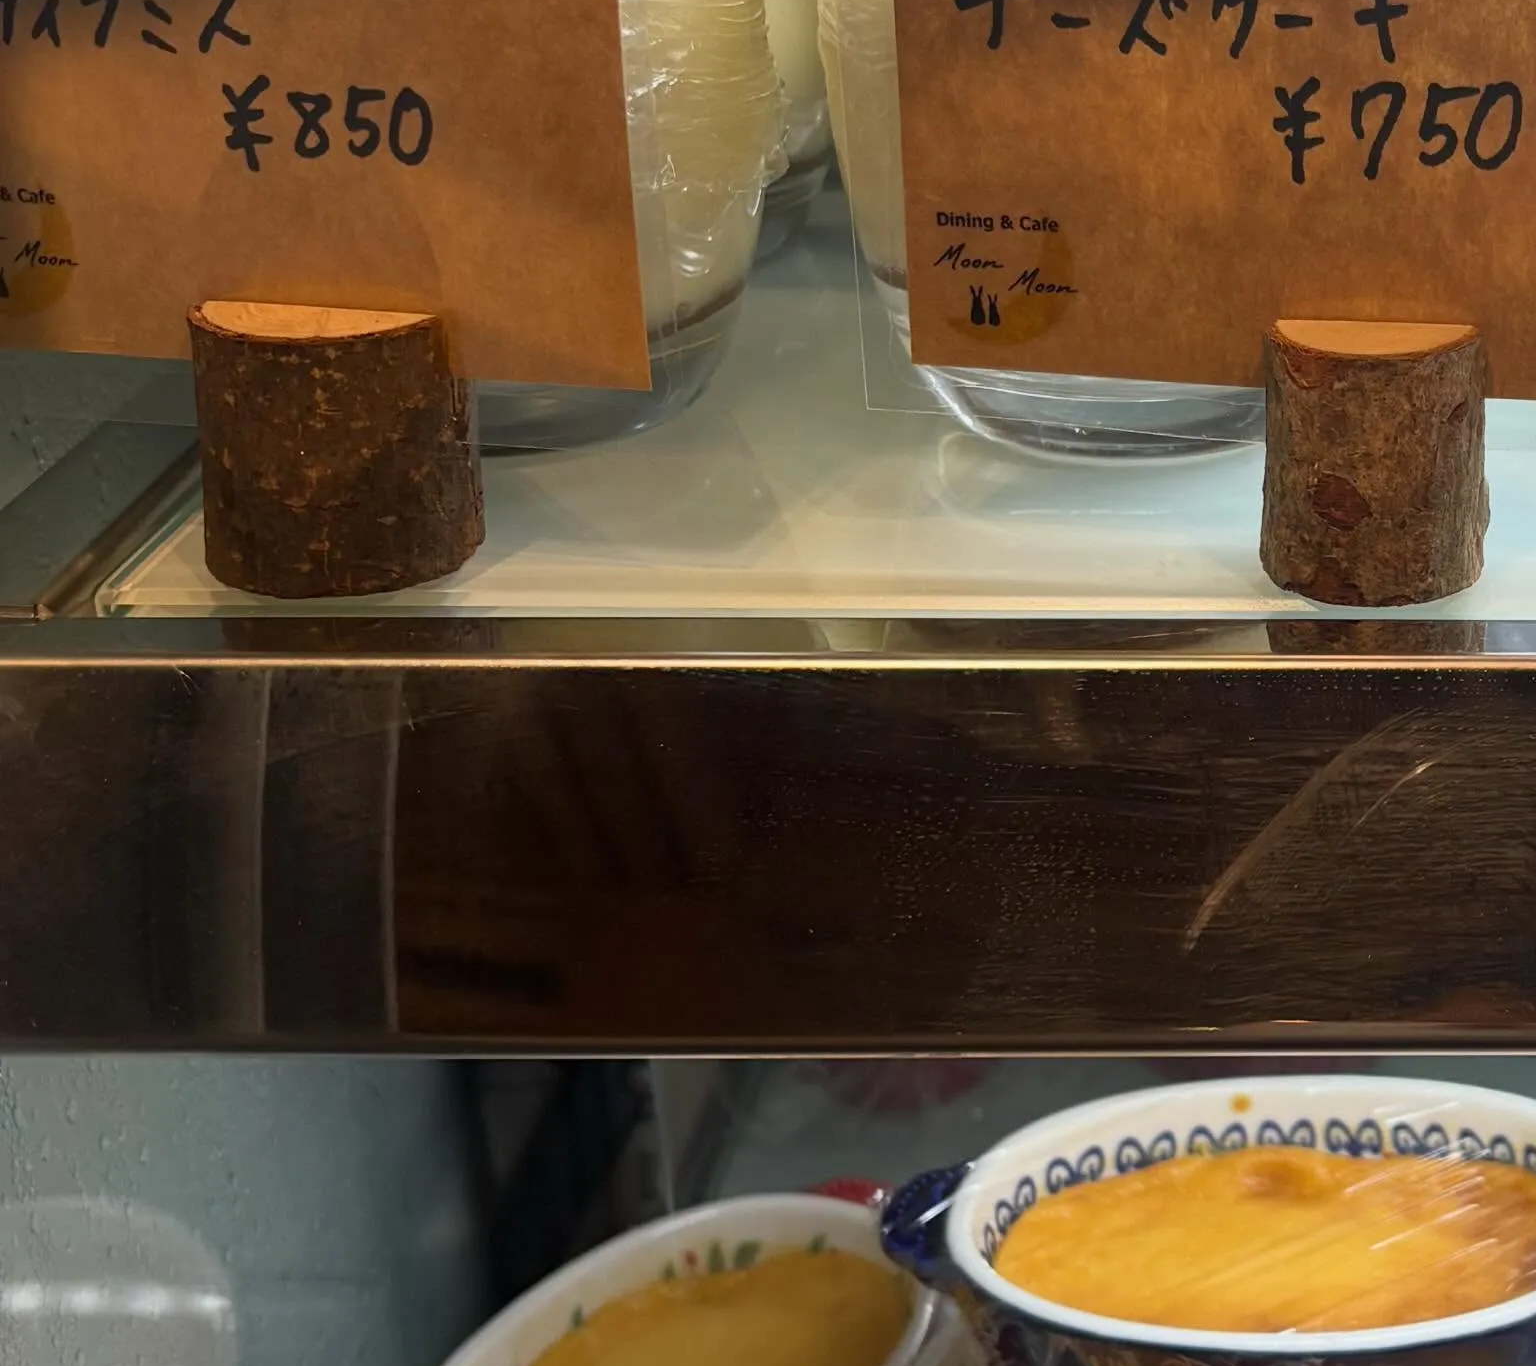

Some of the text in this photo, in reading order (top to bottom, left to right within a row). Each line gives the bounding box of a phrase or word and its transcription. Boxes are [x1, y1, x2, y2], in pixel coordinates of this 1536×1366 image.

[222, 74, 434, 172] ¥850
[1273, 76, 1524, 185] ¥750
[17, 188, 56, 205] Cafe
[936, 212, 1059, 233] Dining & Cafe
[14, 240, 80, 268] Moon
[933, 242, 1004, 271] Moon
[1007, 267, 1079, 295] Moon
